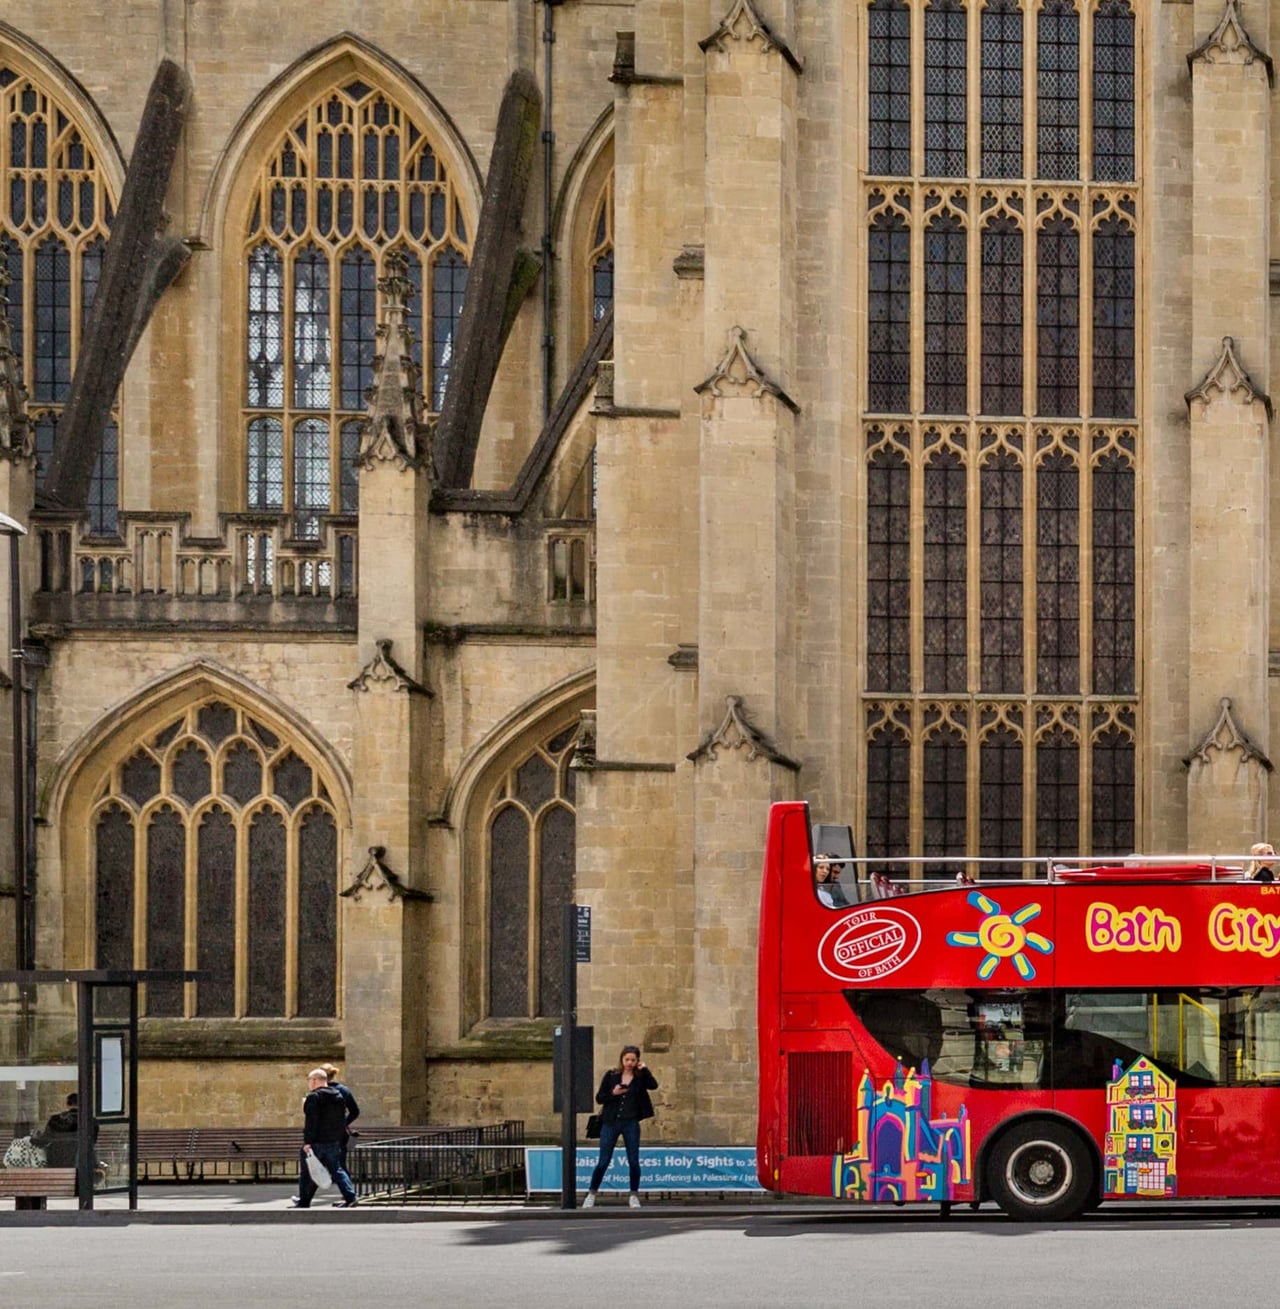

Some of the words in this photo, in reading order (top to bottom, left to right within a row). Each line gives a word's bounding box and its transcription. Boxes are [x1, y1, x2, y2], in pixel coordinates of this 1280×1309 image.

[843, 912, 877, 929] TOUR
[1086, 902, 1181, 952] Bath
[838, 929, 902, 959] OFFICIAL
[858, 969, 873, 978] OF
[875, 955, 901, 975] BATH
[617, 1156, 661, 1167] Voces:
[665, 1156, 692, 1168] Holy
[696, 1156, 734, 1168] Sights
[736, 1159, 745, 1167] to
[613, 1175, 630, 1183] Hop
[655, 1174, 691, 1183] Suffering
[702, 1174, 738, 1182] Palestine
